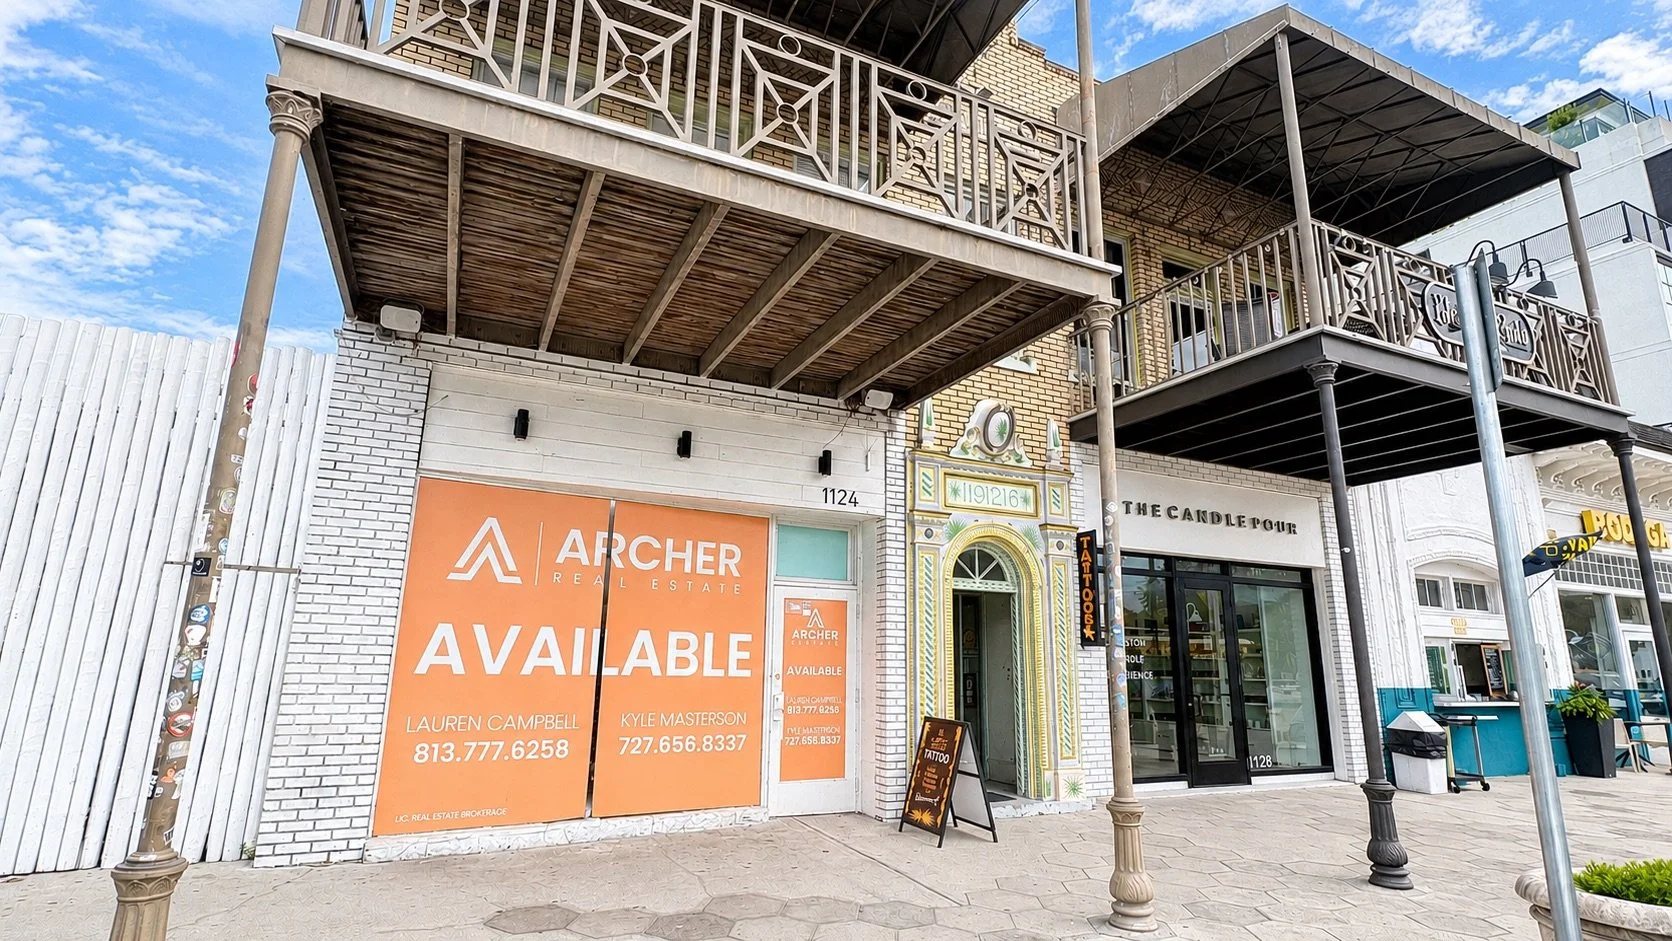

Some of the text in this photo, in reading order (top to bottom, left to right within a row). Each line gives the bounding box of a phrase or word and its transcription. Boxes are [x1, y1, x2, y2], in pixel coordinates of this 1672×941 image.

[822, 487, 859, 508] 1124
[1122, 501, 1297, 535] THE CANDLE POUR
[1582, 510, 1671, 549] BODGA
[555, 528, 742, 578] ARCHER
[553, 572, 741, 595] REAL ESTATE
[791, 629, 839, 640] ARCHER
[413, 622, 753, 678] AVAILABLE
[787, 666, 842, 676] AVAILABLE
[406, 713, 581, 733] LAUREN CAMPBELL
[620, 711, 747, 728] KYLE MASTERSON
[413, 739, 570, 764] 813.777.6258
[618, 734, 748, 756] 727.656.8337
[924, 748, 949, 764] TATTOO
[1249, 754, 1273, 769] 1128
[411, 813, 430, 822] REAL
[432, 810, 459, 820] ESTATE
[461, 807, 508, 819] BROKERAGE
